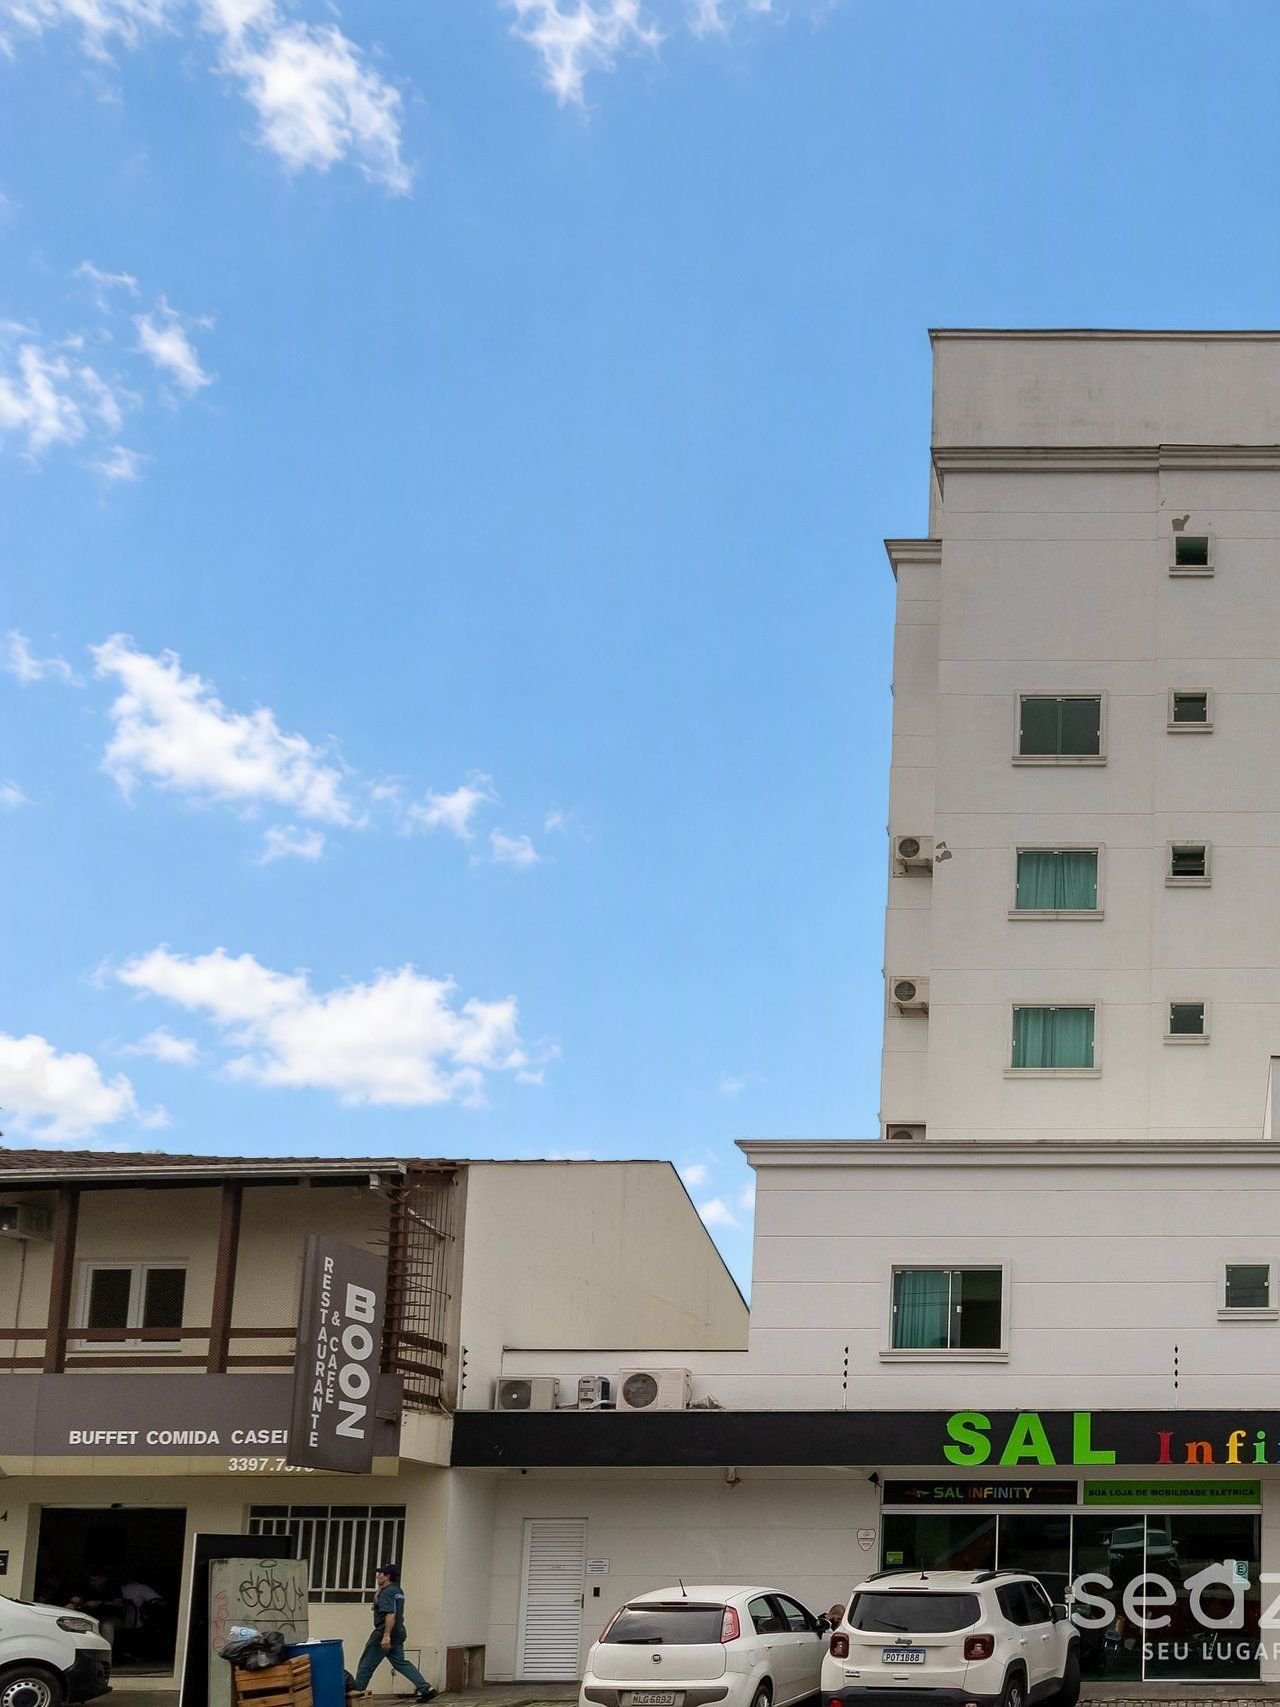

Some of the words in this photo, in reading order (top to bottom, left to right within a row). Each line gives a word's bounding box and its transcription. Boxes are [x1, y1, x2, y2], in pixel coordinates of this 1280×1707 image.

[331, 1311, 341, 1327] &
[309, 1256, 334, 1448] RESTAURANTE
[335, 1283, 376, 1440] BOOZ
[325, 1336, 339, 1404] CAFÉ
[69, 1430, 138, 1445] BUFFET
[146, 1430, 220, 1445] COMIDA
[943, 1412, 1116, 1466] SAL
[934, 1487, 964, 1498] SAL
[968, 1487, 1033, 1498] INFINITY
[1088, 1489, 1107, 1497] SUA
[1110, 1489, 1133, 1497] LOJA
[1136, 1489, 1148, 1497] DE
[1150, 1489, 1207, 1497] MOBILIDADE
